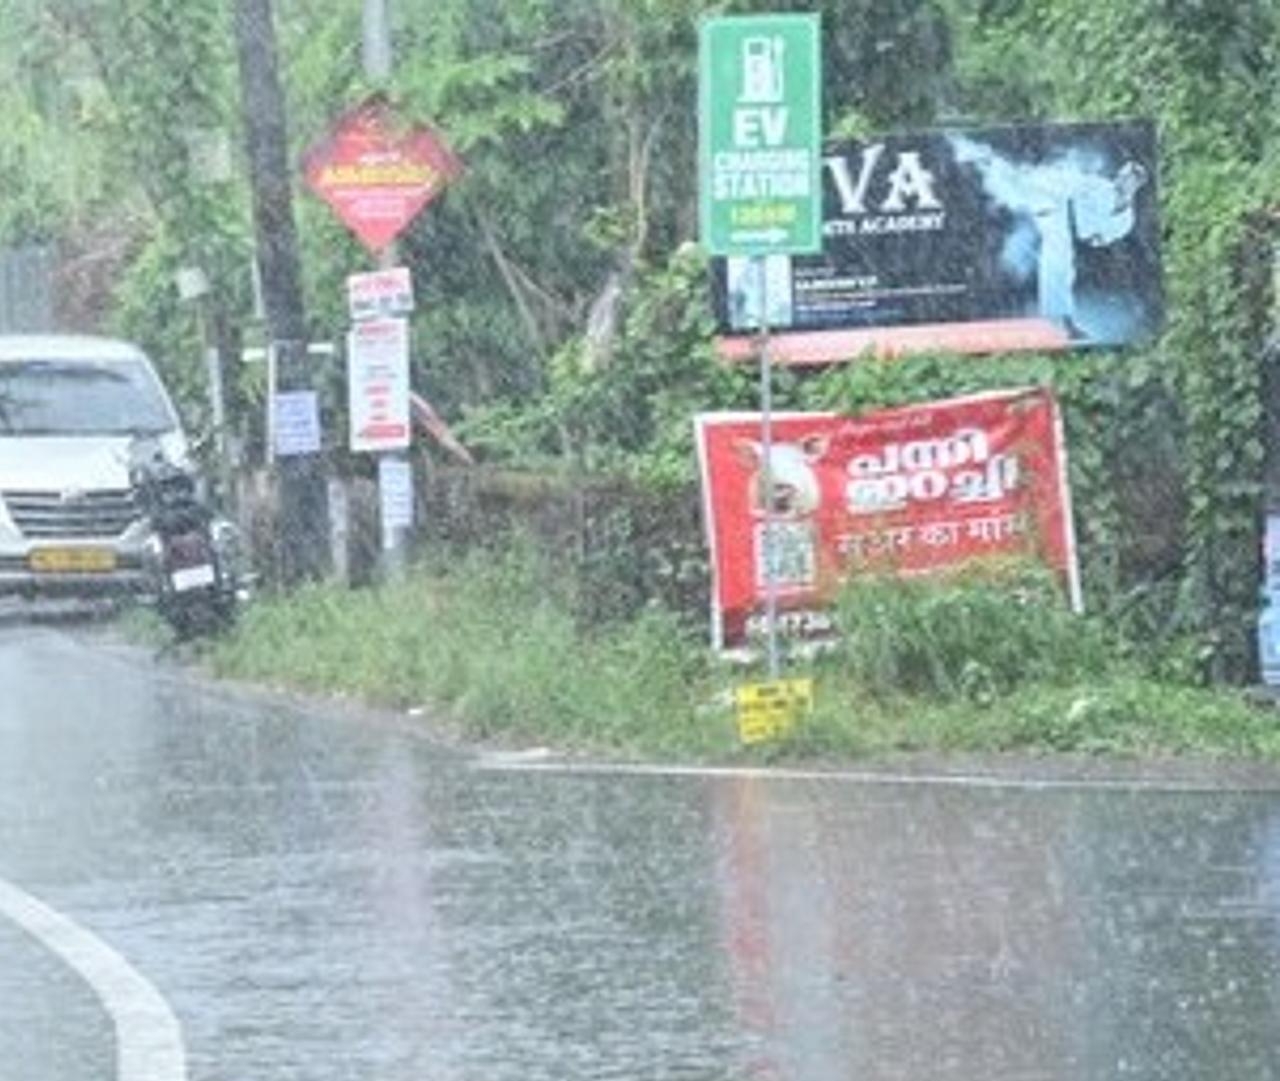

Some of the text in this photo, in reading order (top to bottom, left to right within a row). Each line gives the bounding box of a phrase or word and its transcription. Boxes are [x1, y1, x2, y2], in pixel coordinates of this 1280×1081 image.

[734, 106, 789, 146] EV
[713, 149, 810, 173] CHARGING
[713, 173, 810, 200] STATION
[824, 143, 943, 213] VA
[859, 211, 946, 234] ACADEMY
